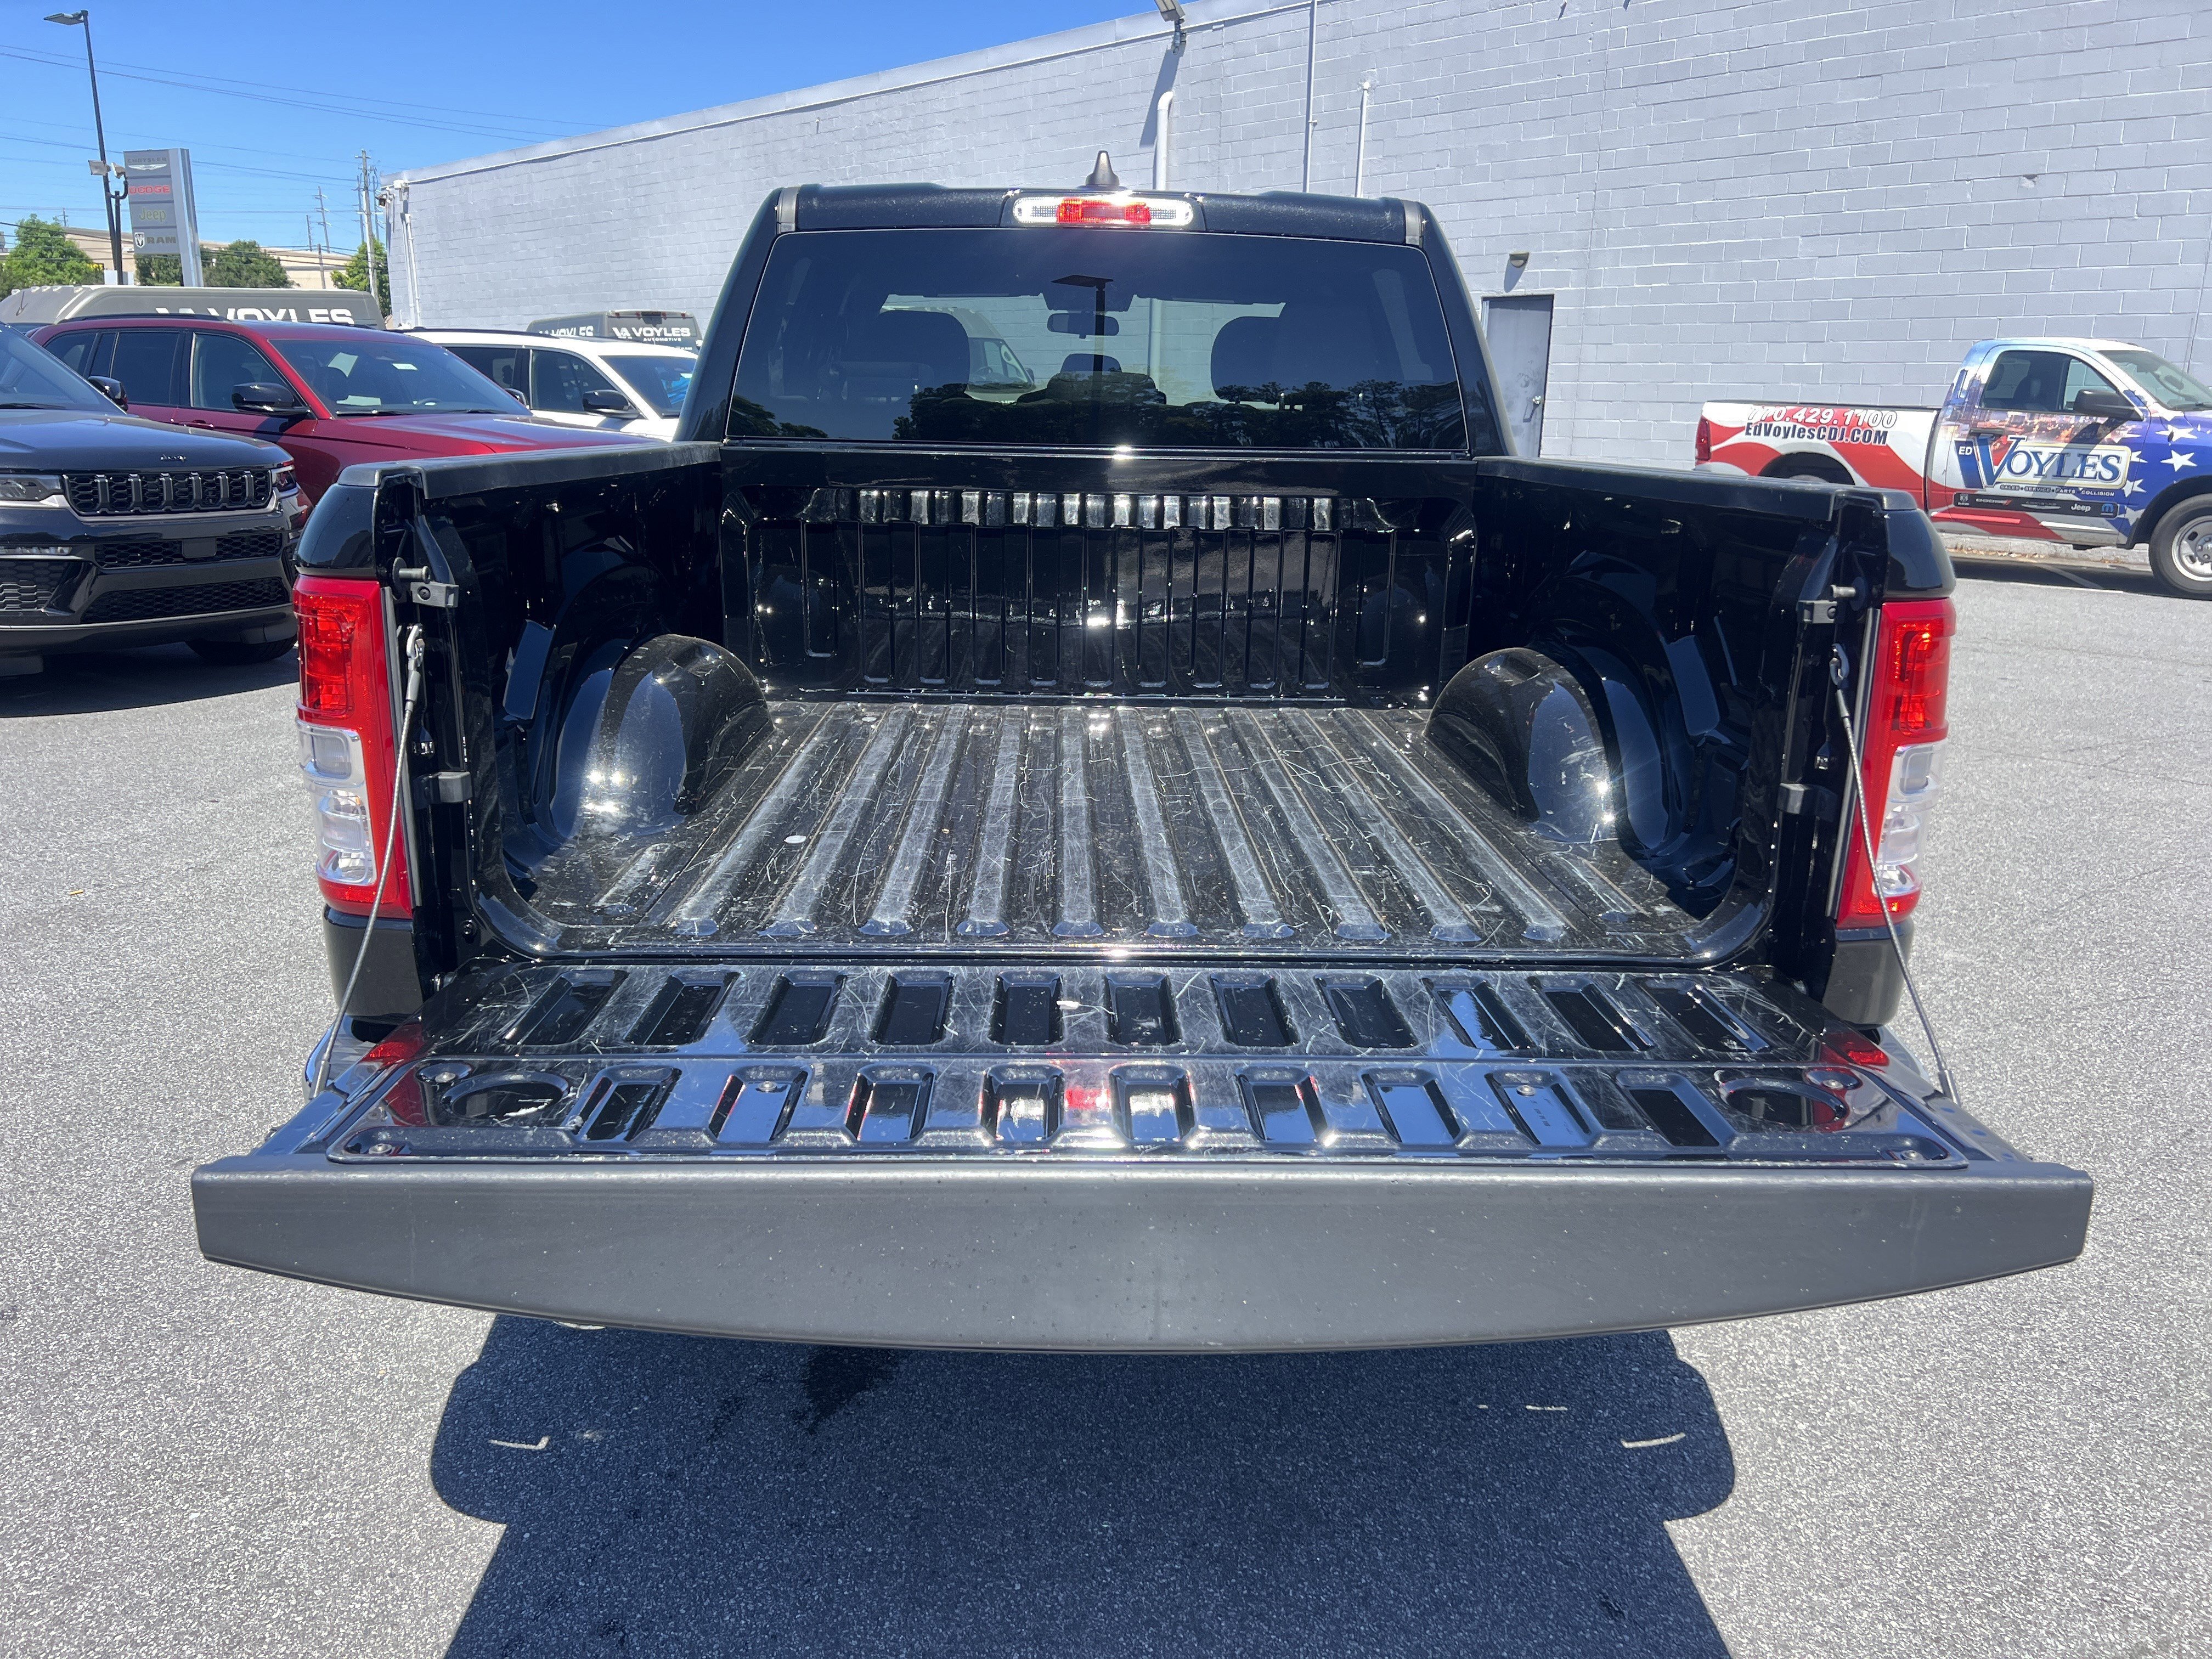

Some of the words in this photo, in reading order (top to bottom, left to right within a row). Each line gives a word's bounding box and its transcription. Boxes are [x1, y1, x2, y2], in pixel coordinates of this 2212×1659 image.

[129, 185, 170, 194] DODGE
[139, 207, 166, 222] Jeep
[631, 327, 691, 337] VOYLES
[1748, 406, 1897, 428] 770.429.1100
[1745, 421, 1888, 445] EdVoylesCDJ.COM
[1959, 445, 1973, 455] ED
[1975, 435, 2122, 487] VOYLES
[2070, 503, 2091, 512] Jeep
